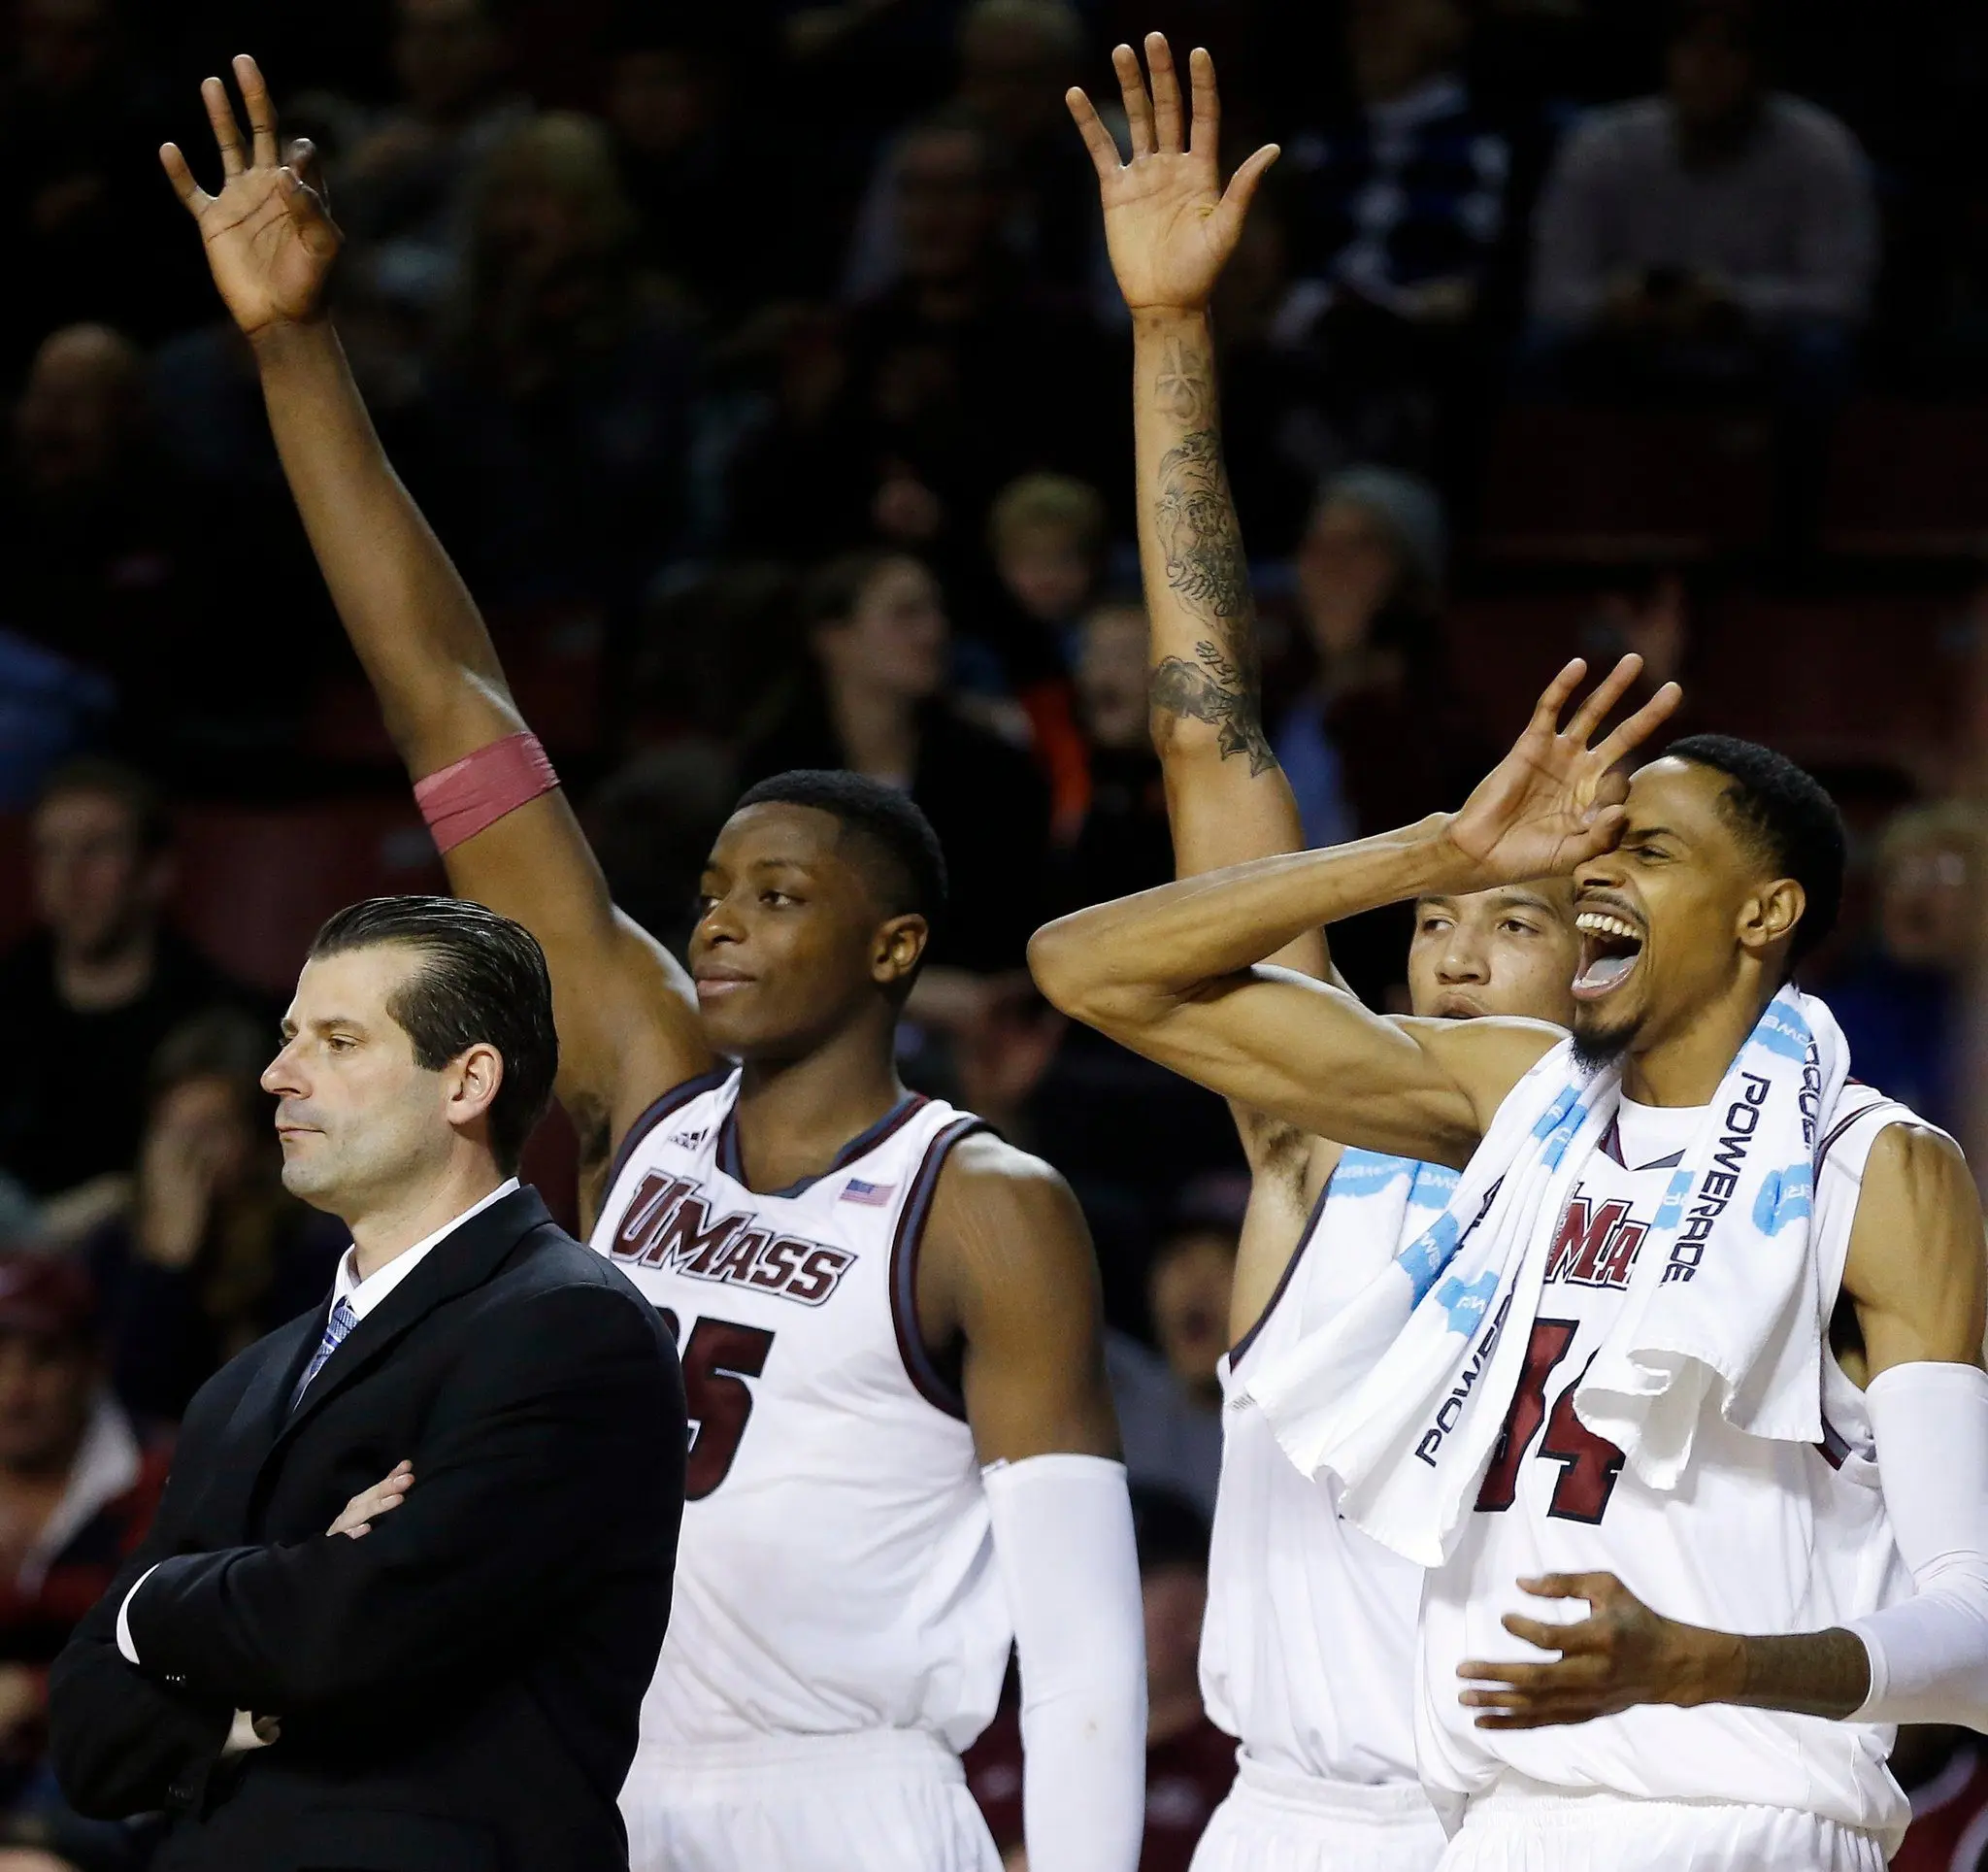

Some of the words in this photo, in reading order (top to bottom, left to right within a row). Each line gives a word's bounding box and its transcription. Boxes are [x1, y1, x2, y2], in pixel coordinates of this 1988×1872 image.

[609, 1167, 859, 1309] UMASS
[1661, 1071, 1772, 1284] POWERADE
[654, 1304, 777, 1502] 5
[1474, 1317, 1627, 1525] 14
